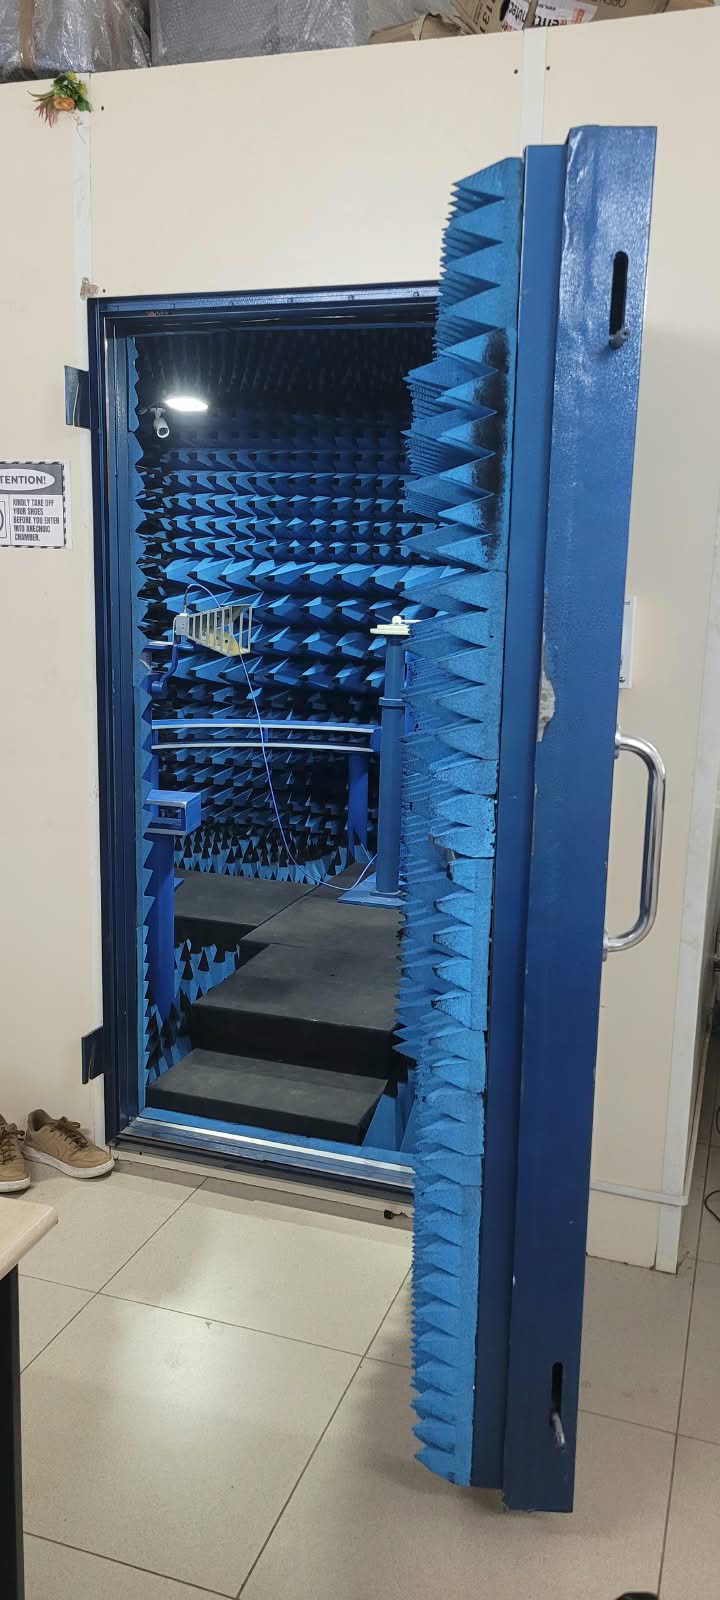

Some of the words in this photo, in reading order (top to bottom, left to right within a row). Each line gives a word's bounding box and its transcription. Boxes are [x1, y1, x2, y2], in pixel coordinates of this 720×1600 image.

[12, 498, 30, 506] KINDLY
[32, 498, 44, 506] TAKE
[44, 500, 54, 508] OFF
[14, 508, 26, 516] YOUR
[28, 508, 44, 516] SHOES
[14, 516, 32, 524] BEFORE
[32, 516, 42, 524] YOU
[44, 516, 60, 524] ENTER
[14, 524, 24, 532] INTO
